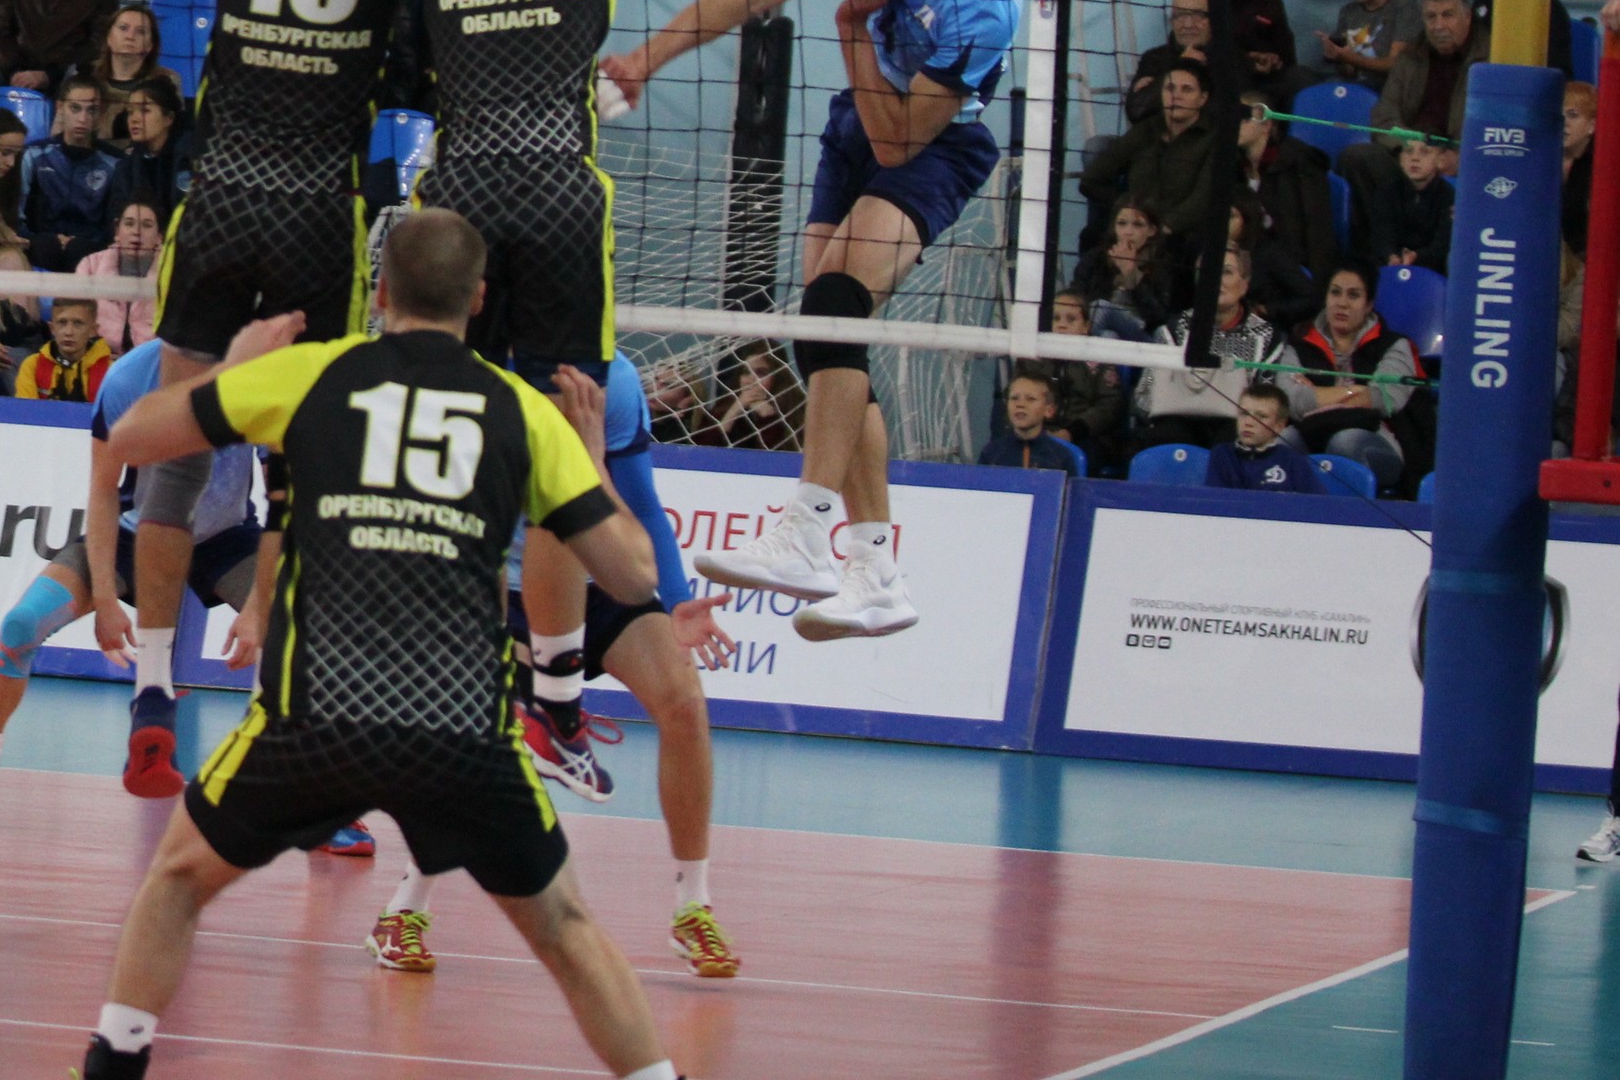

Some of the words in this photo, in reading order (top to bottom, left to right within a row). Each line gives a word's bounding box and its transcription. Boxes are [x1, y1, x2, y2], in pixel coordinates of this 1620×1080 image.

[461, 6, 561, 35] ОБЛАСТЬ
[240, 45, 339, 75] ОБЛАСТЬ
[1484, 127, 1525, 143] FIVB
[1470, 227, 1517, 389] JINLING
[348, 380, 487, 501] 15
[348, 525, 460, 560] ОБЛАСТЬ
[1129, 612, 1369, 645] WWW.ONETEAMSAKHALIN.RU
